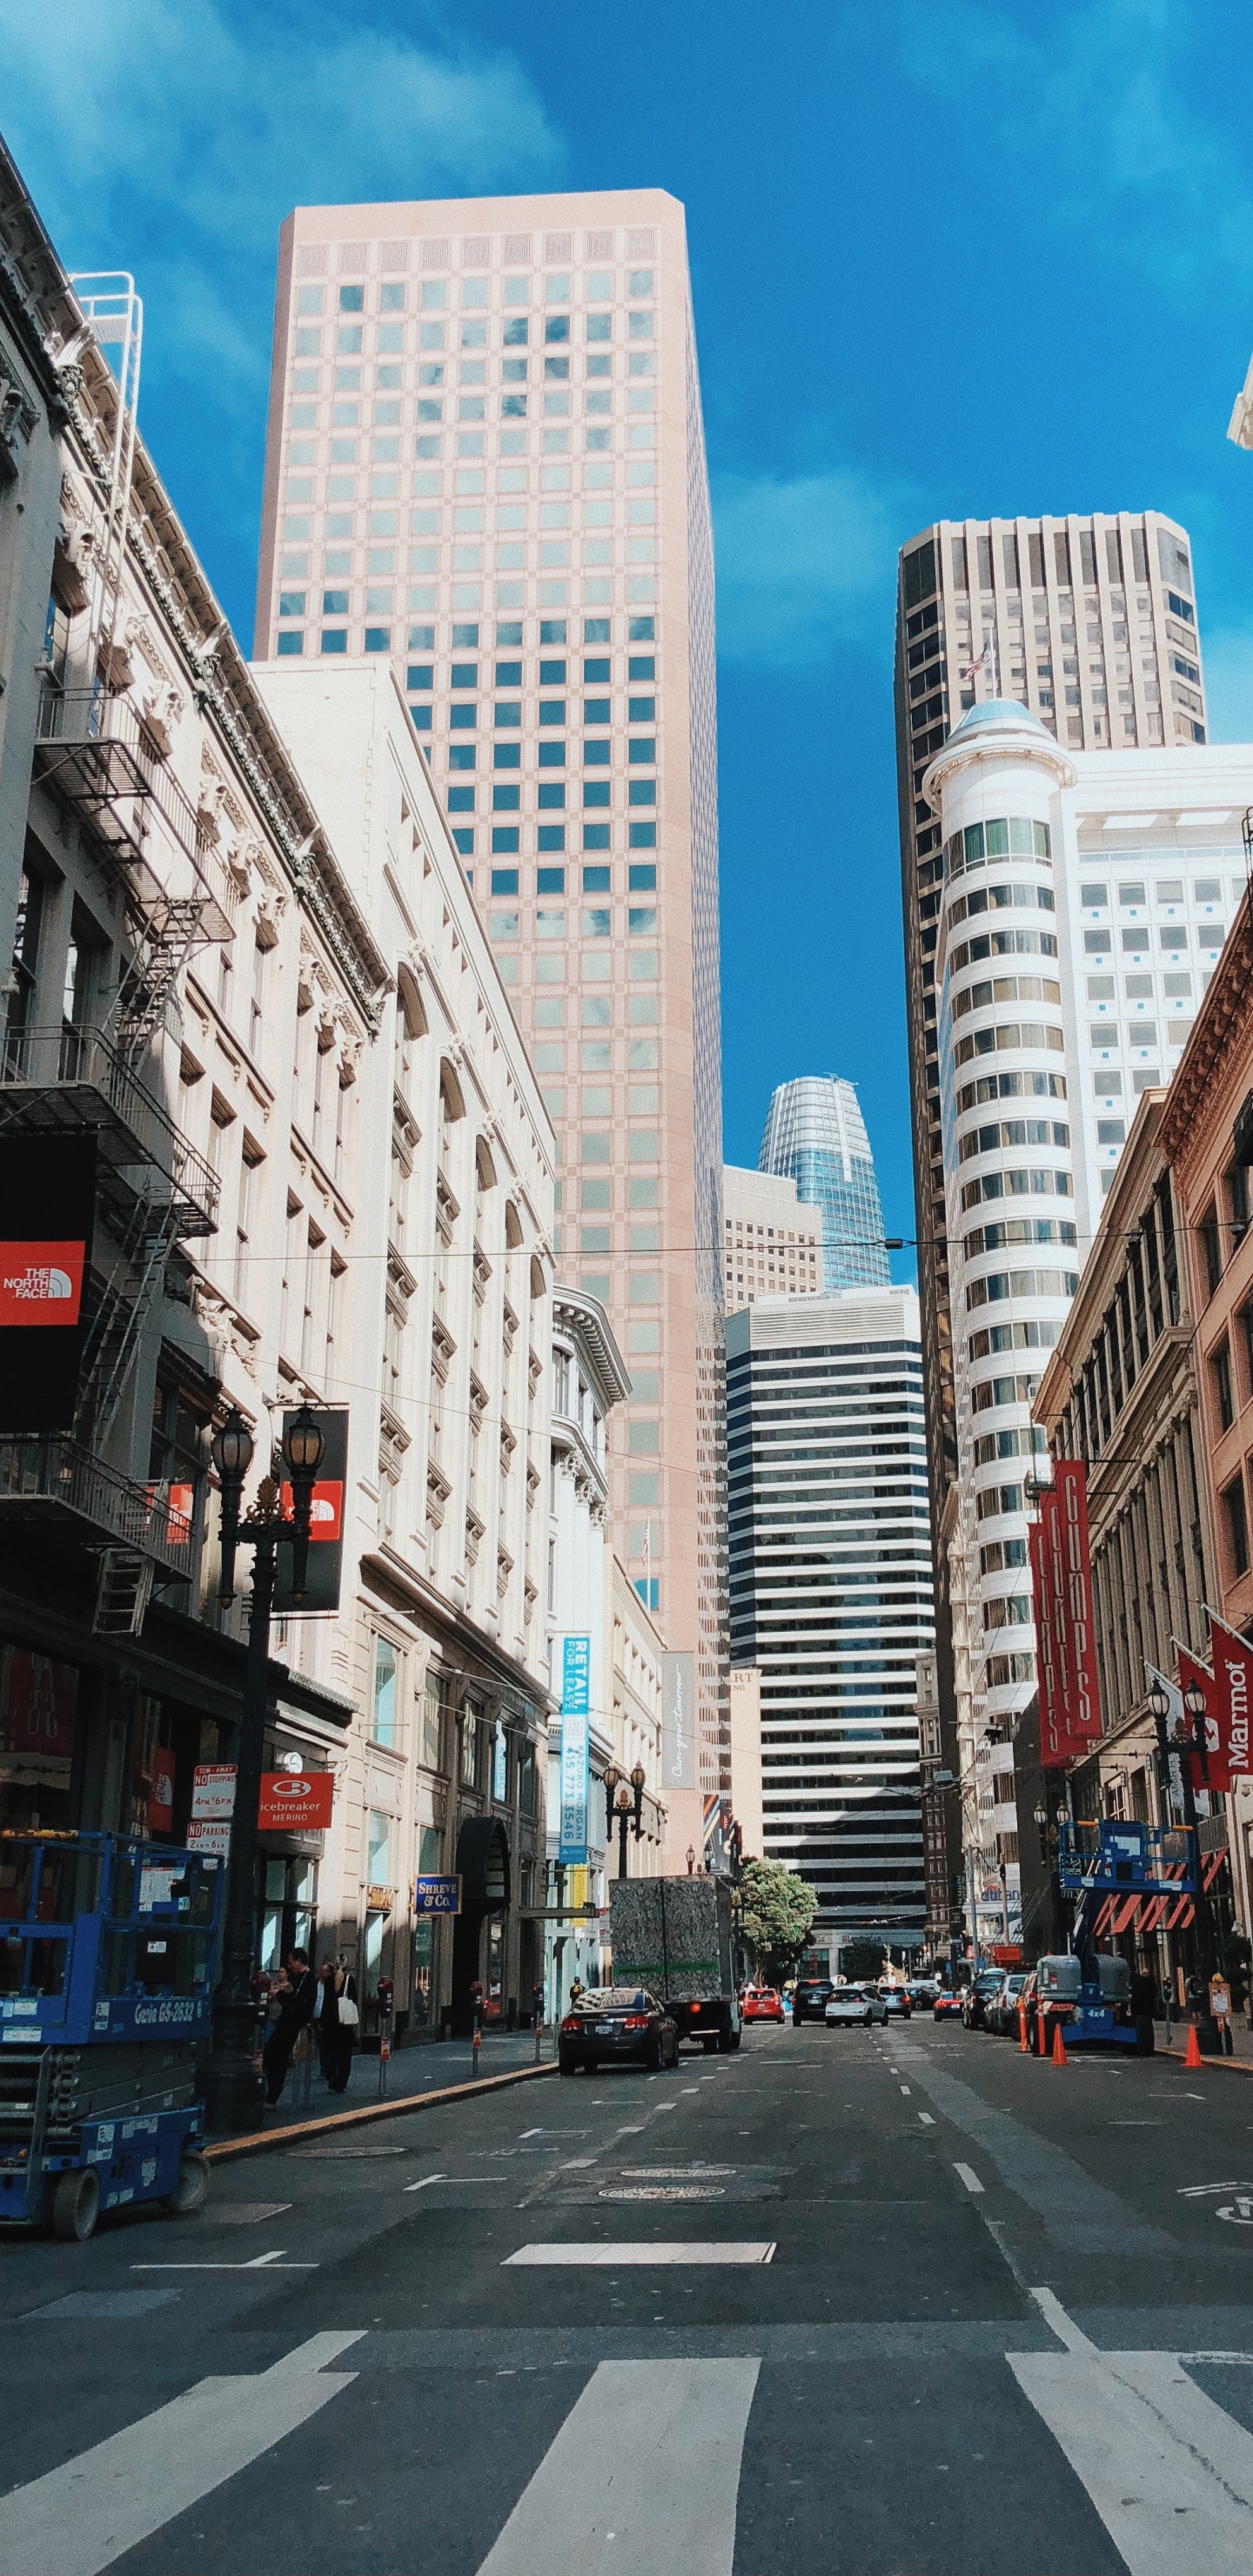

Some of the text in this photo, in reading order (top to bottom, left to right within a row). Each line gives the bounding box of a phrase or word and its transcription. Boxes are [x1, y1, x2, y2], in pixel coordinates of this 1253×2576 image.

[24, 1268, 50, 1278] THE
[3, 1278, 49, 1289] NORTH
[15, 1288, 48, 1298] FACE
[1065, 1474, 1091, 1721] GUMPS
[565, 1640, 574, 1709] FOR LEASE
[574, 1640, 587, 1709] RETAIL
[1225, 1660, 1250, 1768] Marmot
[567, 1728, 583, 1737] POST
[671, 1751, 682, 1777] Own
[195, 1774, 235, 1785] NO STOPPING
[564, 1746, 575, 1840] 415.773.3546
[260, 1801, 321, 1812] icebreaker
[575, 1793, 584, 1840] MORGAN
[189, 1824, 229, 1836] NO PARKING
[135, 2003, 157, 2023] Genie
[1088, 2009, 1105, 2018] 4x4
